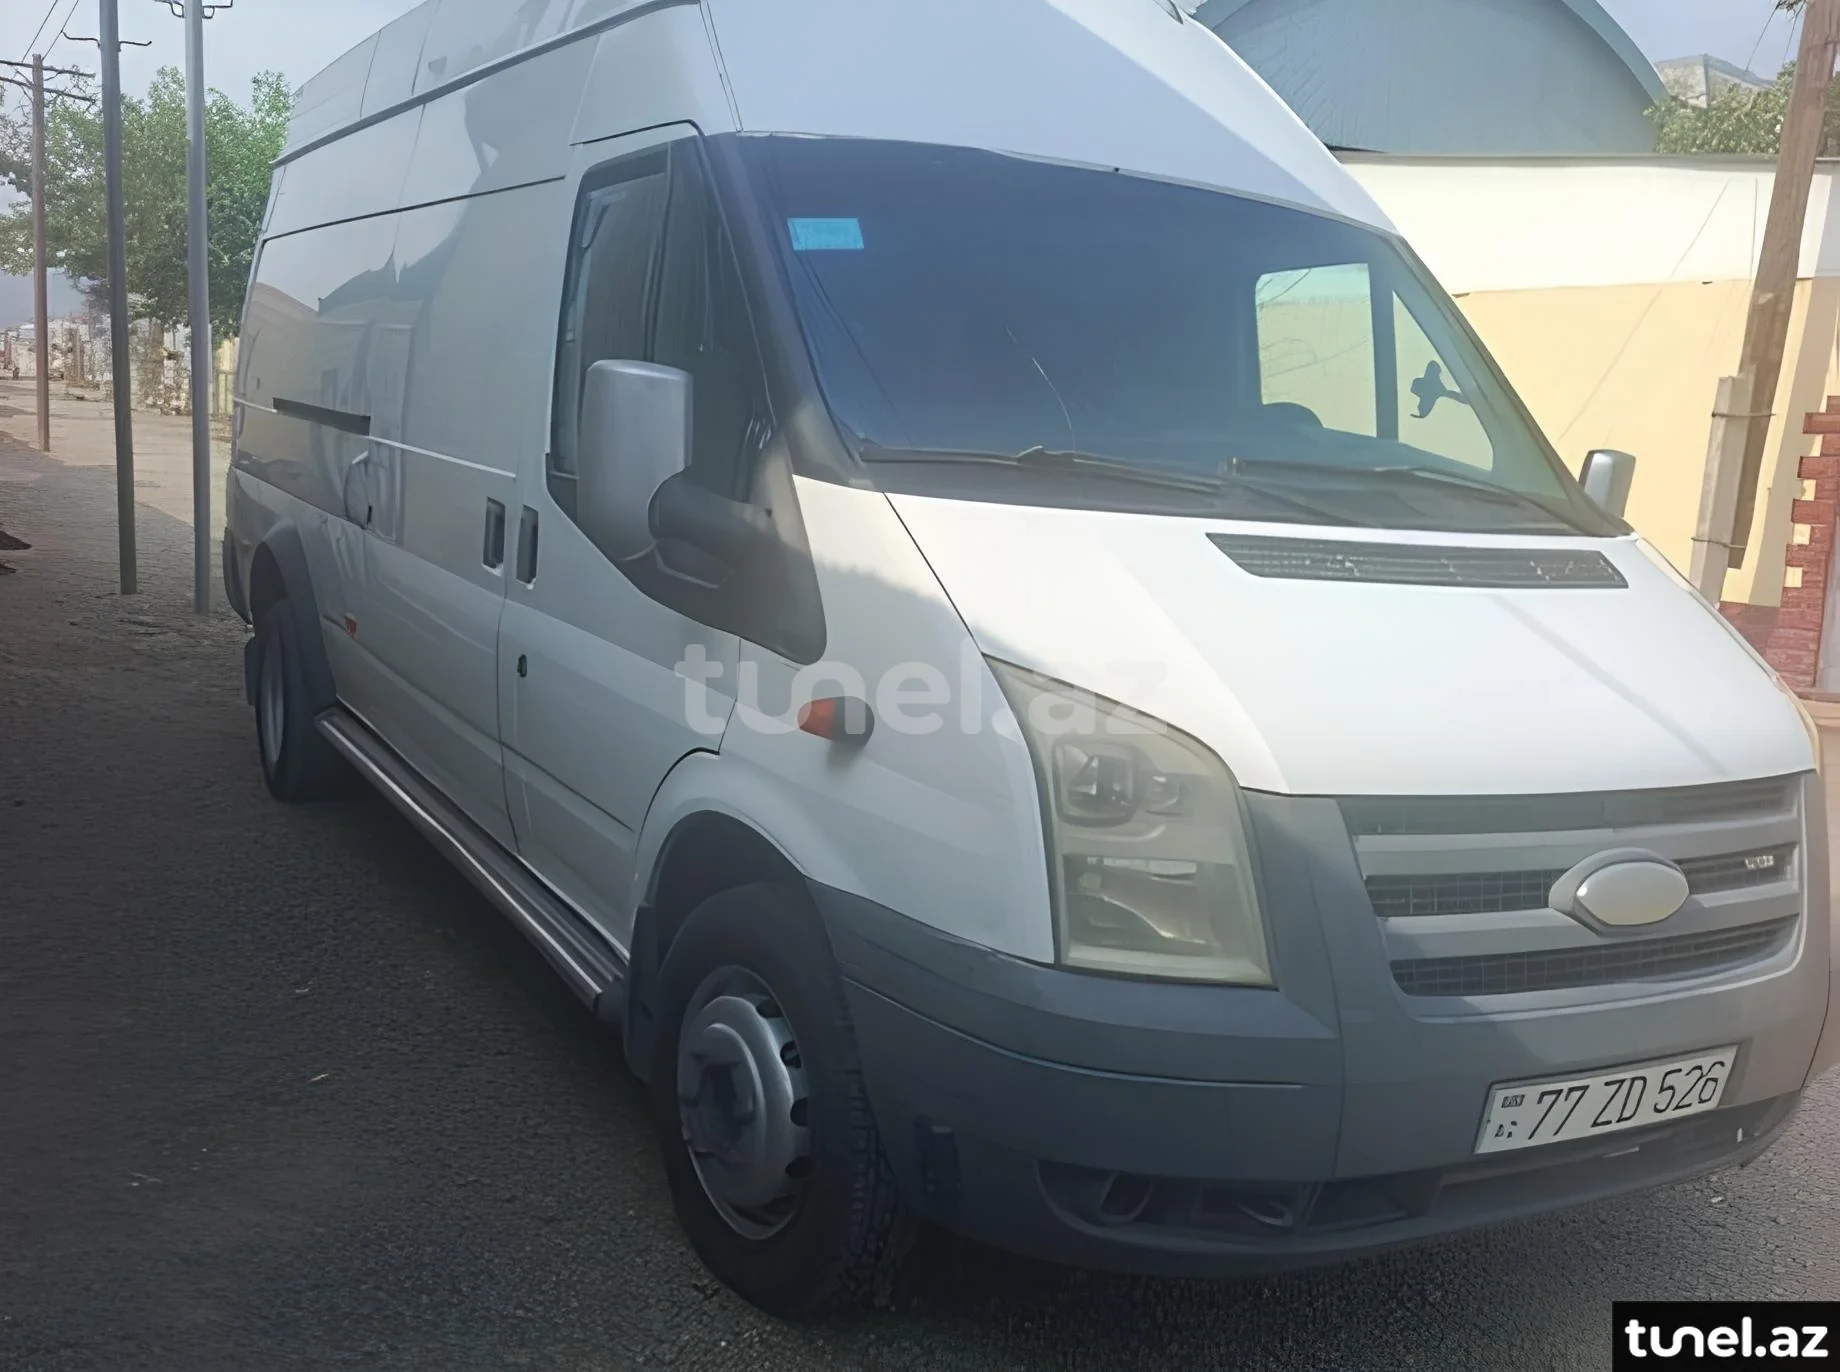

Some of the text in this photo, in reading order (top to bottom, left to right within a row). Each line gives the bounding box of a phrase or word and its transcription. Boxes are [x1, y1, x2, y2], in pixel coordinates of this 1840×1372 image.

[1527, 1060, 1725, 1140] 77 ZD 526
